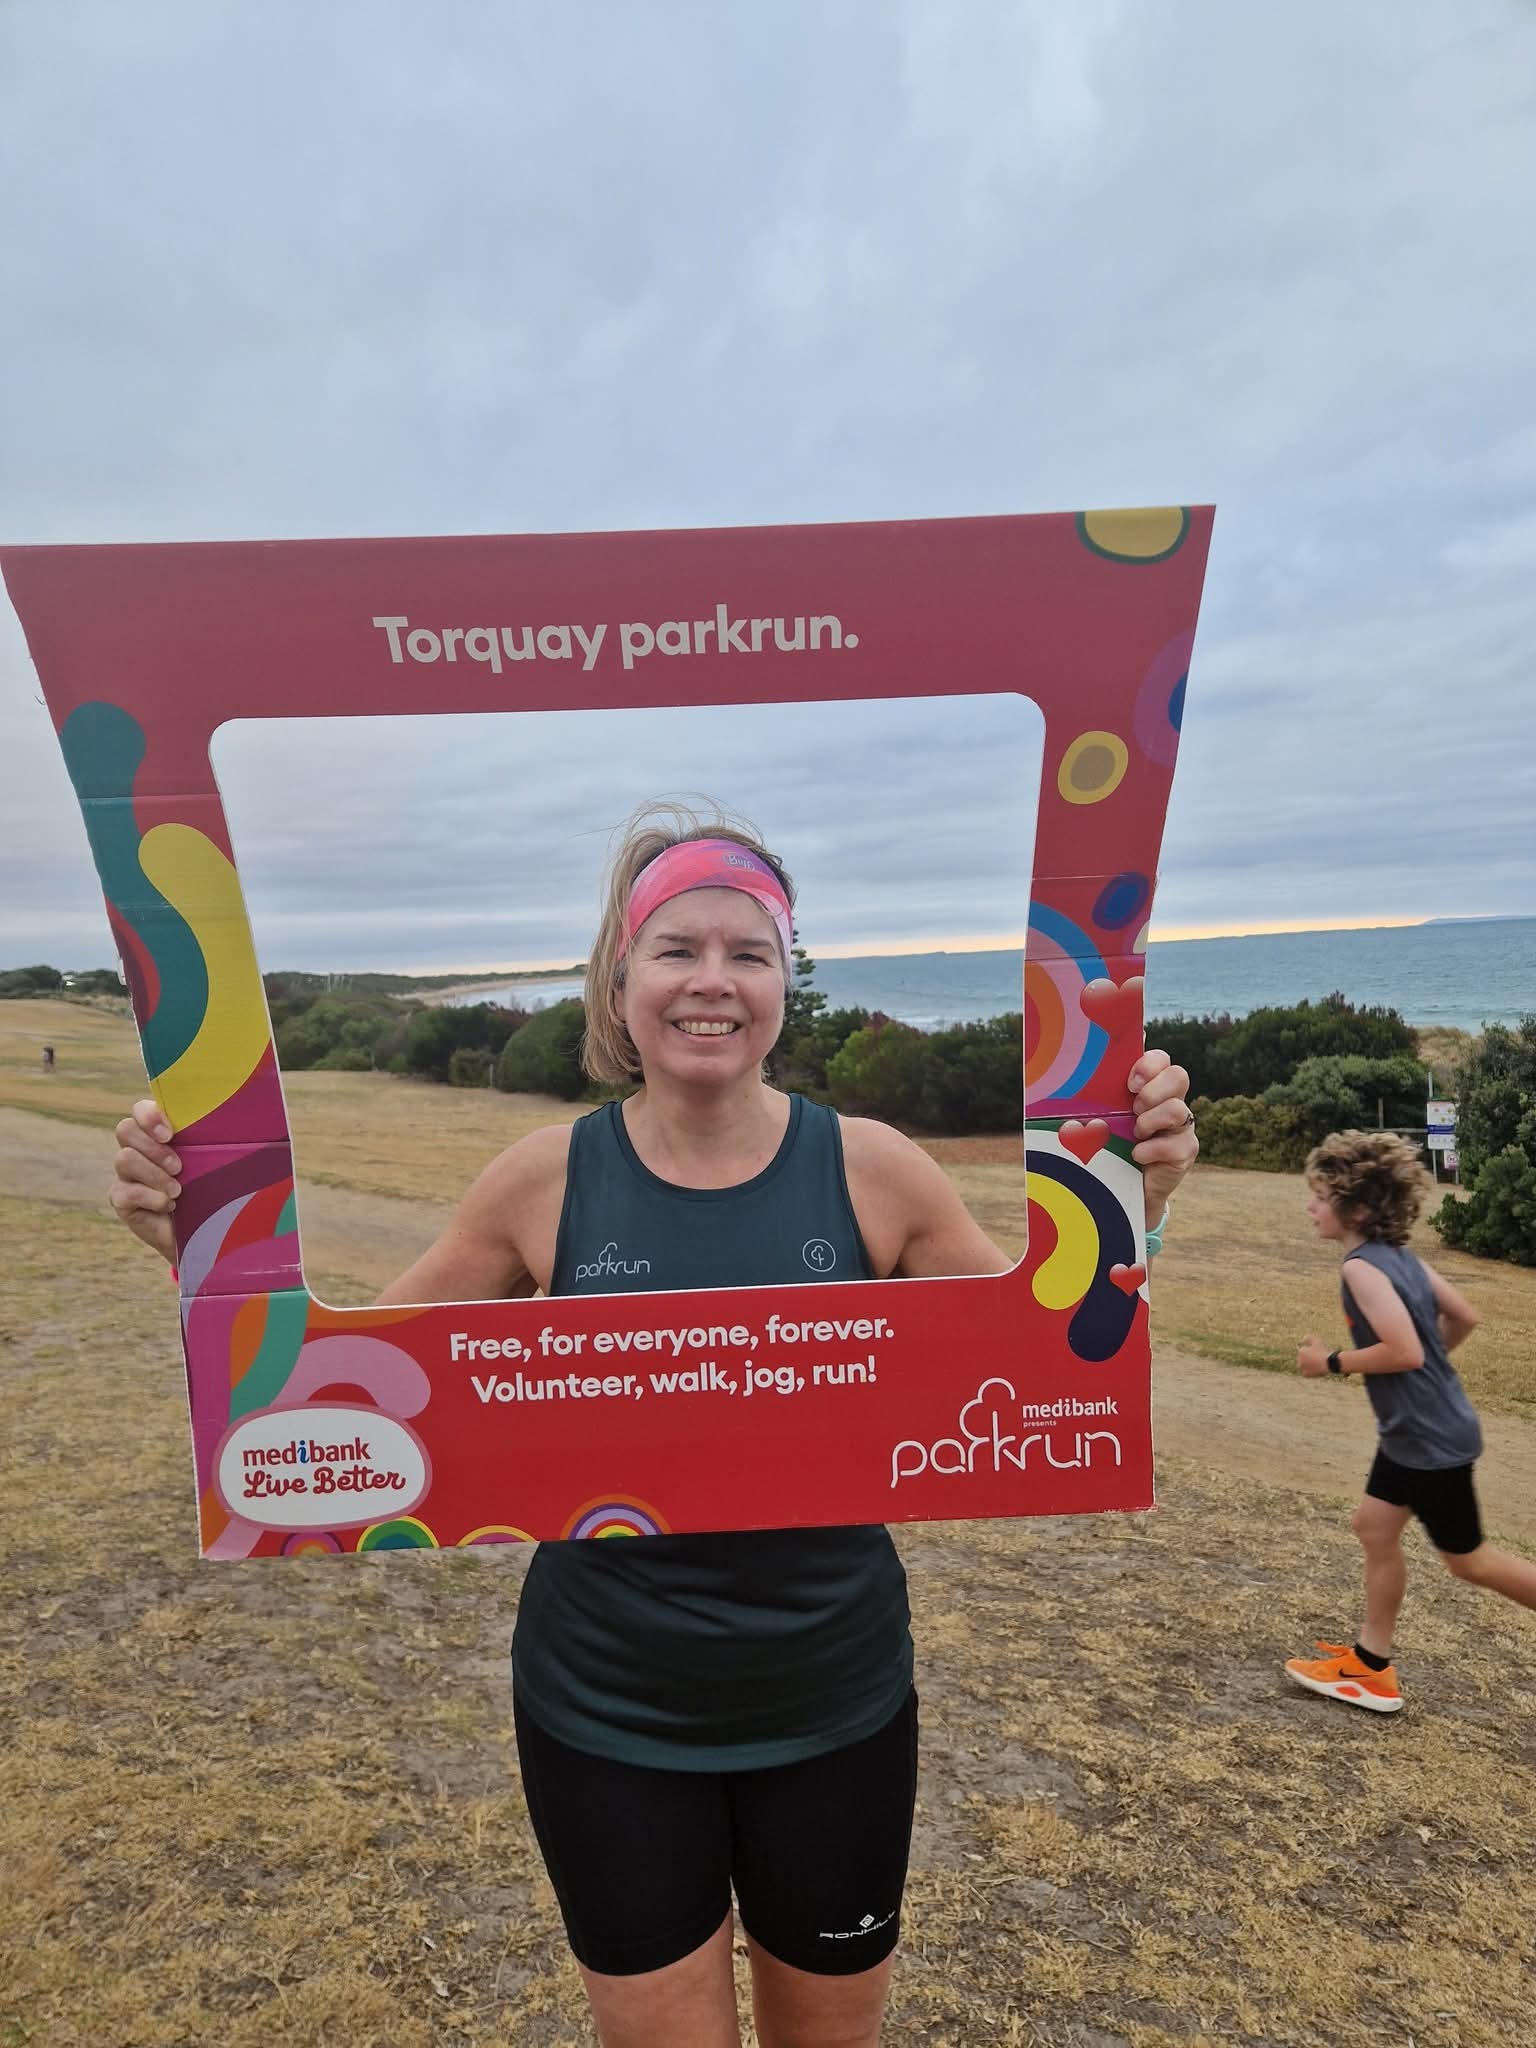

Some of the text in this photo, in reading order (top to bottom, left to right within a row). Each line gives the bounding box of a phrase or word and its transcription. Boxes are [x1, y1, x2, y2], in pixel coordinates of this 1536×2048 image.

[372, 603, 860, 674] Torquay parkrun.
[575, 1242, 651, 1283] parkrun
[450, 1314, 895, 1363] Free, for everyone, forever.
[471, 1354, 877, 1403] Volunteer, walk, jog, run!
[1022, 1396, 1119, 1419] medibank
[1023, 1420, 1057, 1428] presents
[890, 1377, 1121, 1489] parkrun
[242, 1437, 372, 1467] medibank
[243, 1464, 407, 1498] Live Better
[819, 1911, 896, 1938] RONHILL
